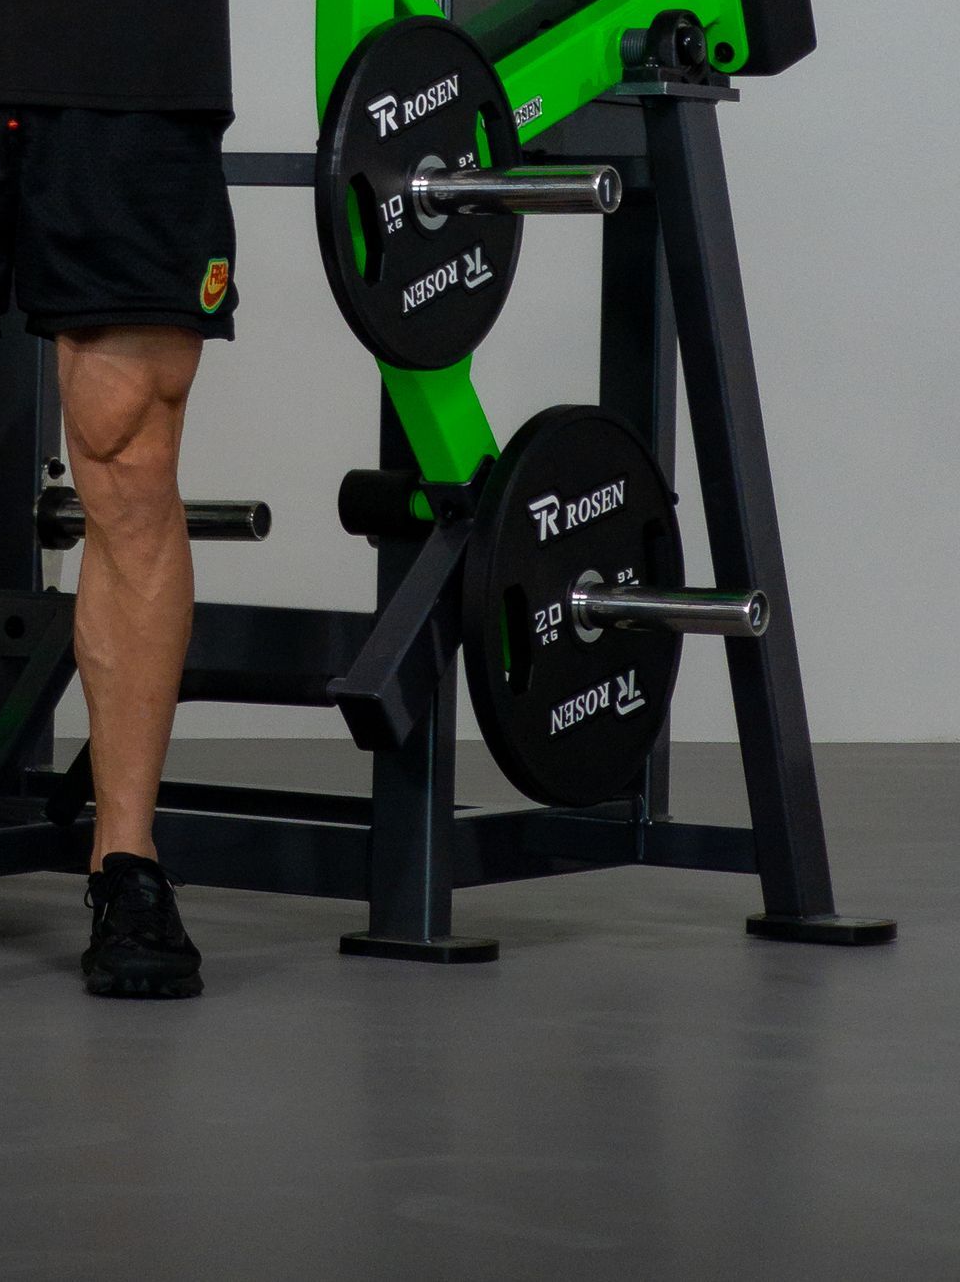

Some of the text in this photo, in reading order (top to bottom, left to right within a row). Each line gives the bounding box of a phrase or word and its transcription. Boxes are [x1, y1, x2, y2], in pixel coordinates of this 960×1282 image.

[402, 74, 459, 125] ROSEN
[604, 178, 611, 203] 1
[380, 194, 404, 222] 10
[387, 220, 403, 234] KG
[402, 260, 459, 313] ROSEN
[565, 480, 625, 530] ROSEN
[535, 603, 562, 634] 20
[752, 602, 761, 627] 2
[542, 631, 559, 646] KG
[550, 681, 611, 735] ROSEN
